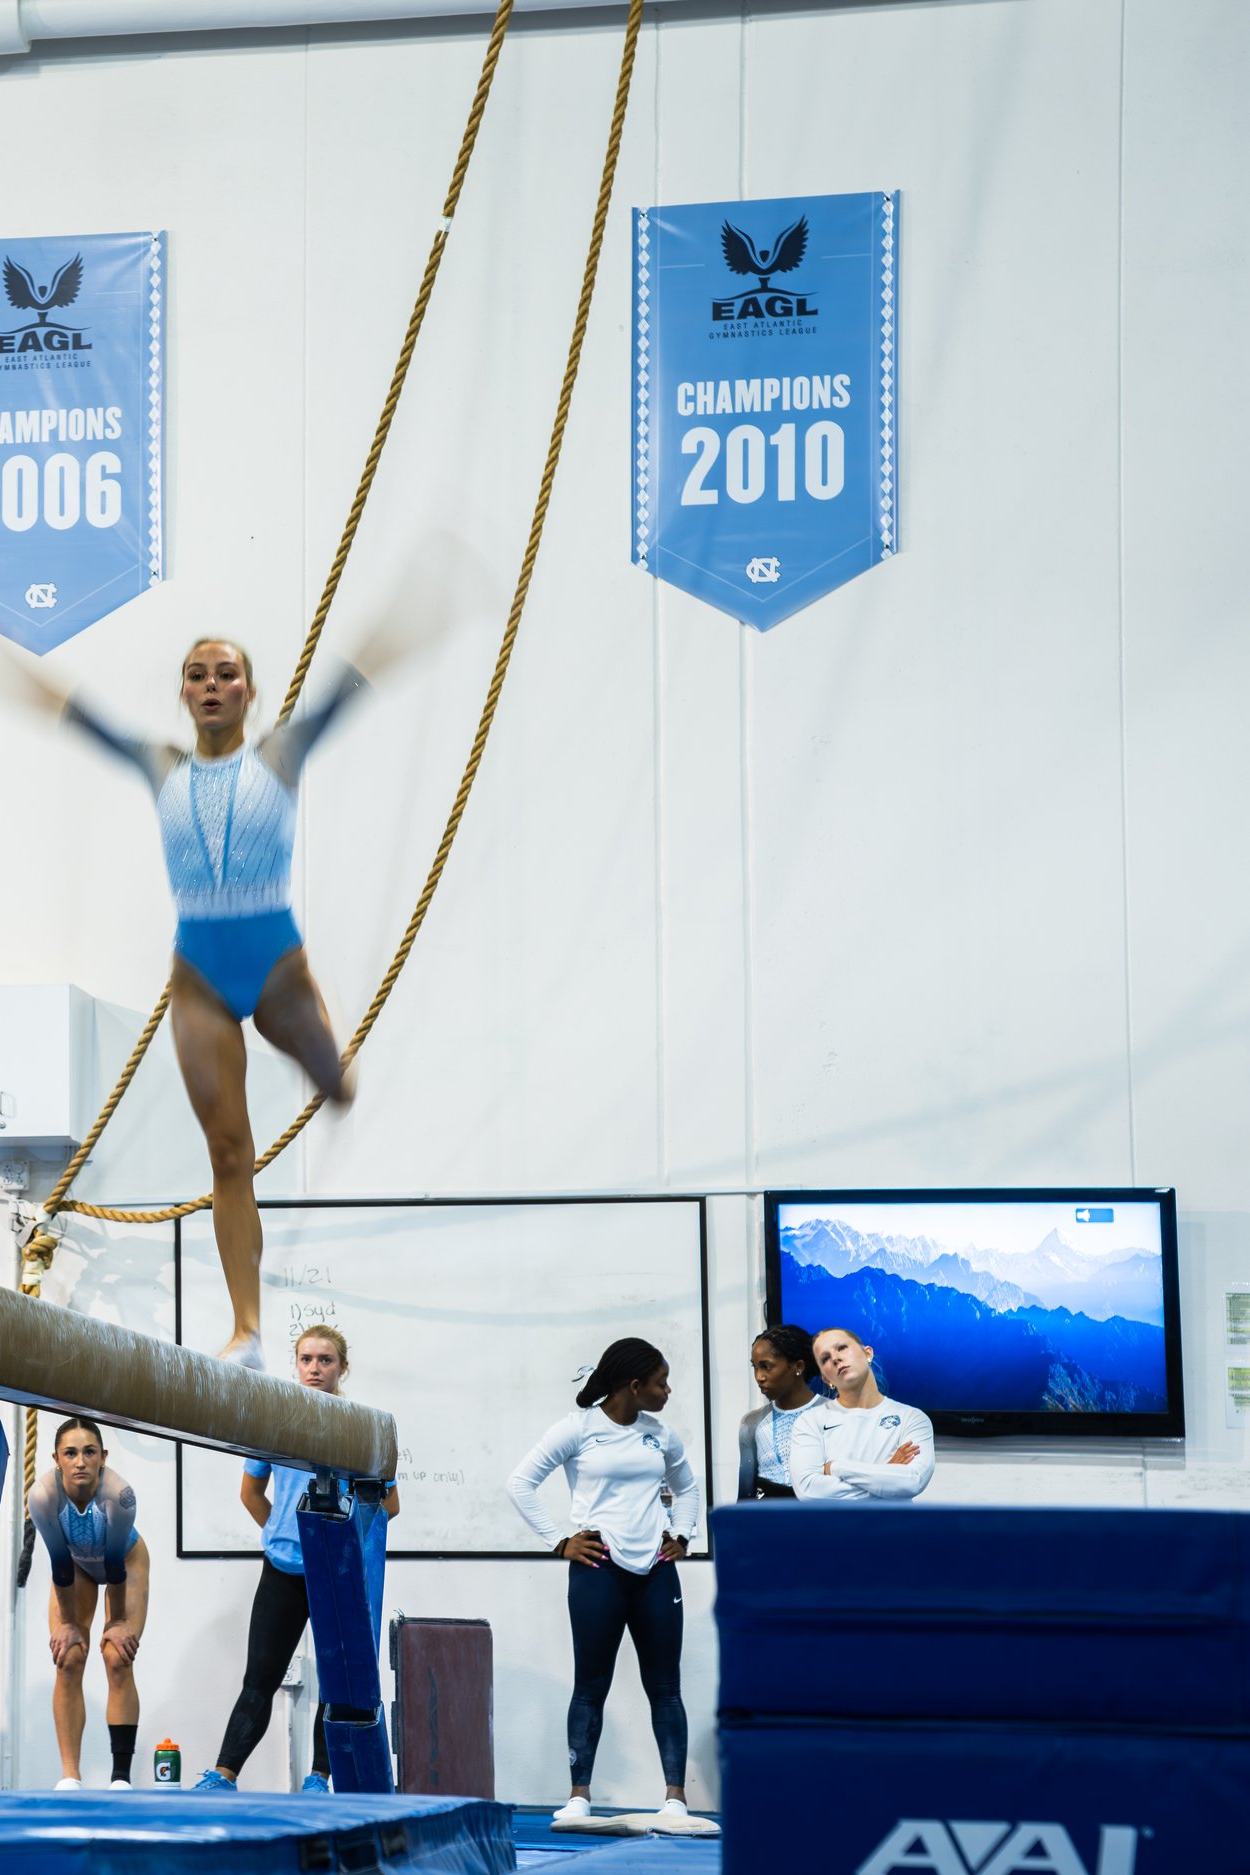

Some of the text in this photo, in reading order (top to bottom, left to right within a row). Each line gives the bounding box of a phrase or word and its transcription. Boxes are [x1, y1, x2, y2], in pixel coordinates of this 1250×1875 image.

[712, 295, 819, 321] EAGL
[709, 327, 817, 340] GYMNASTICS LEAGUE
[723, 319, 803, 330] EAST ATLANTIC
[5, 353, 78, 363] EAST ATLANTIC
[56, 360, 92, 369] LEAGUE
[677, 373, 851, 417] CHAMPIONS
[680, 420, 845, 506] 2010
[283, 1264, 332, 1288] 11/21
